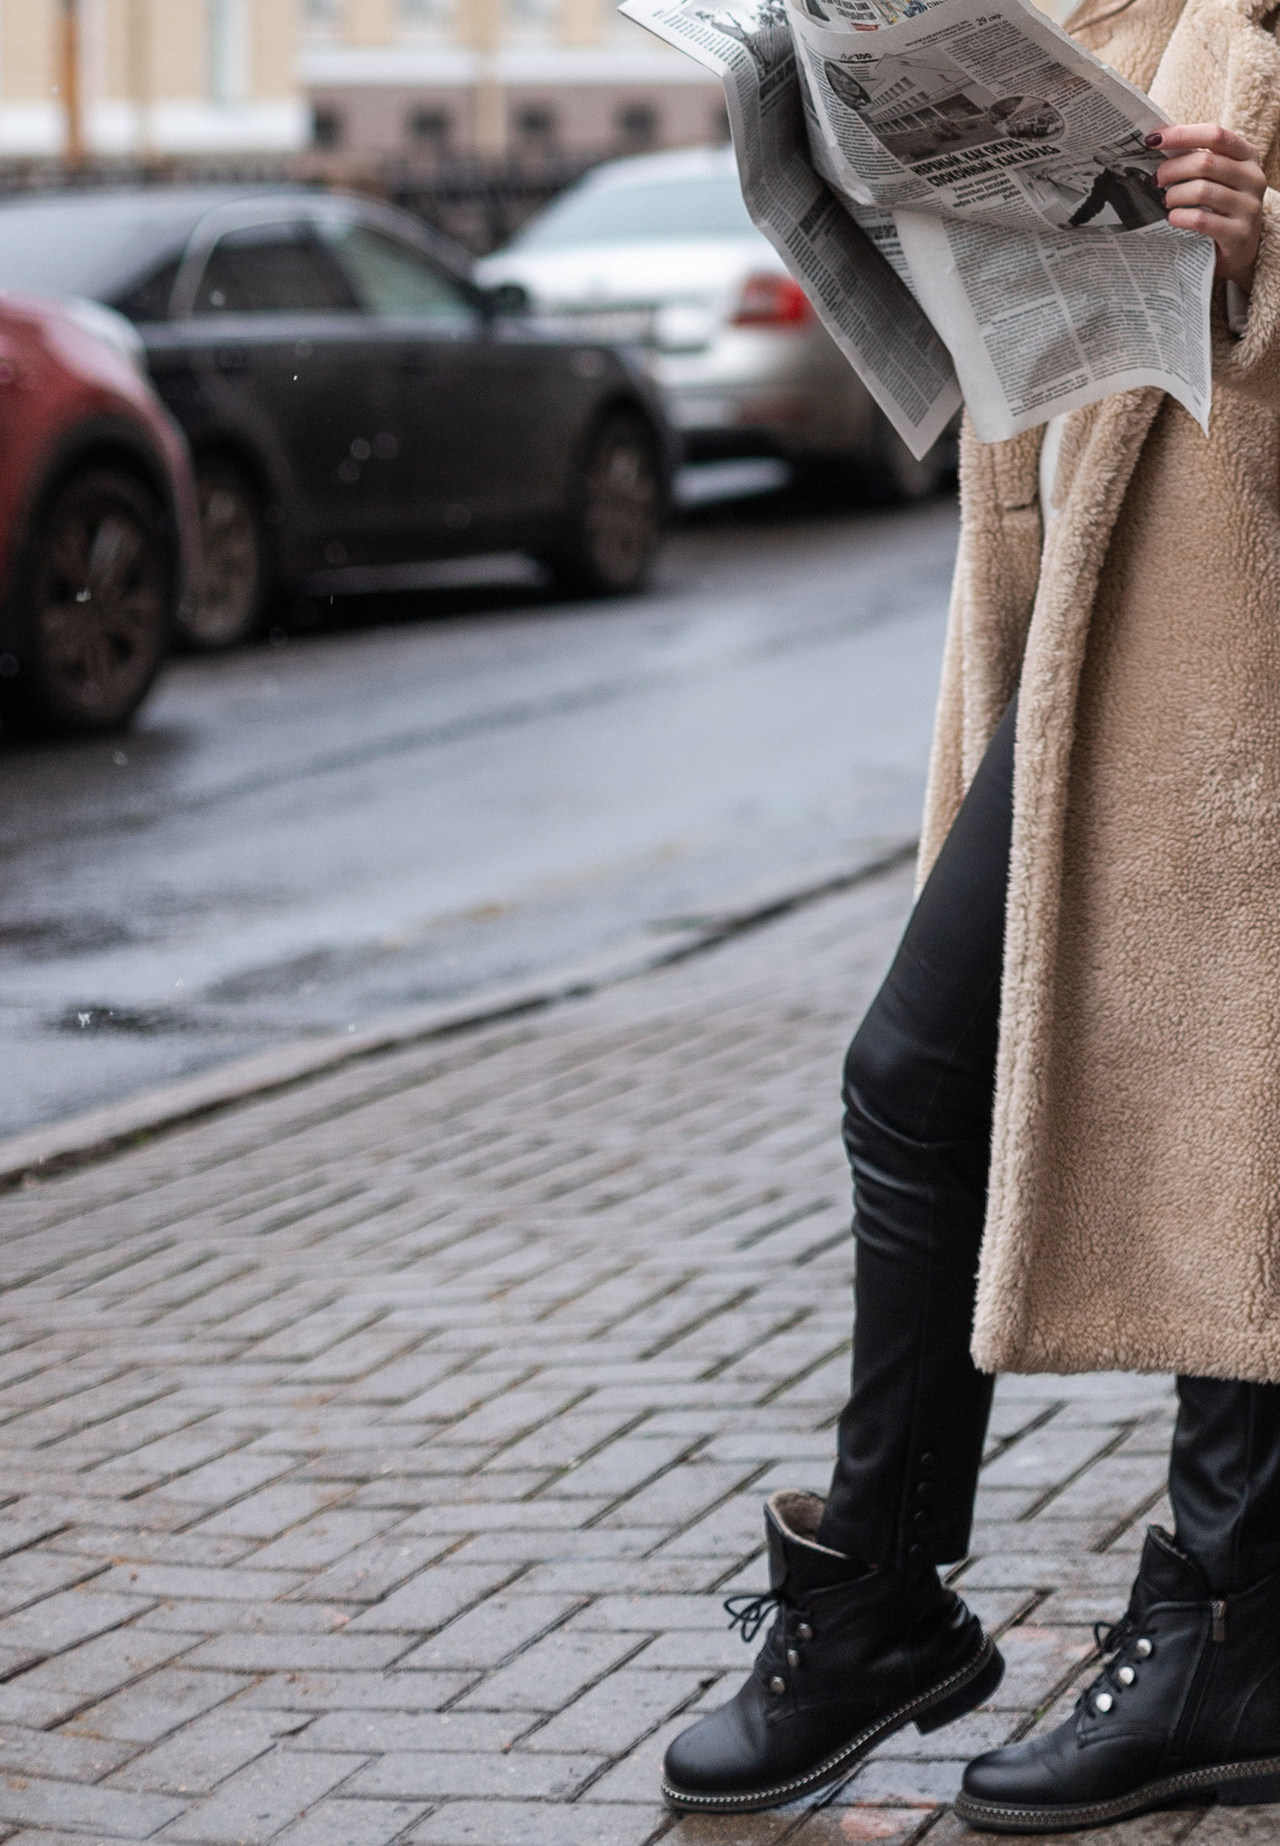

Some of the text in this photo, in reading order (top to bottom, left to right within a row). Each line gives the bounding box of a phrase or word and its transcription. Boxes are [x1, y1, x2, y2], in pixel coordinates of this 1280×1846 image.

[976, 16, 987, 26] 29
[909, 139, 1029, 176] НЕРВНЫЙ, КАК ОКУНЬ,
[926, 145, 1061, 187] СПОКОЙНЫЙ, КАК КАРАСЬ
